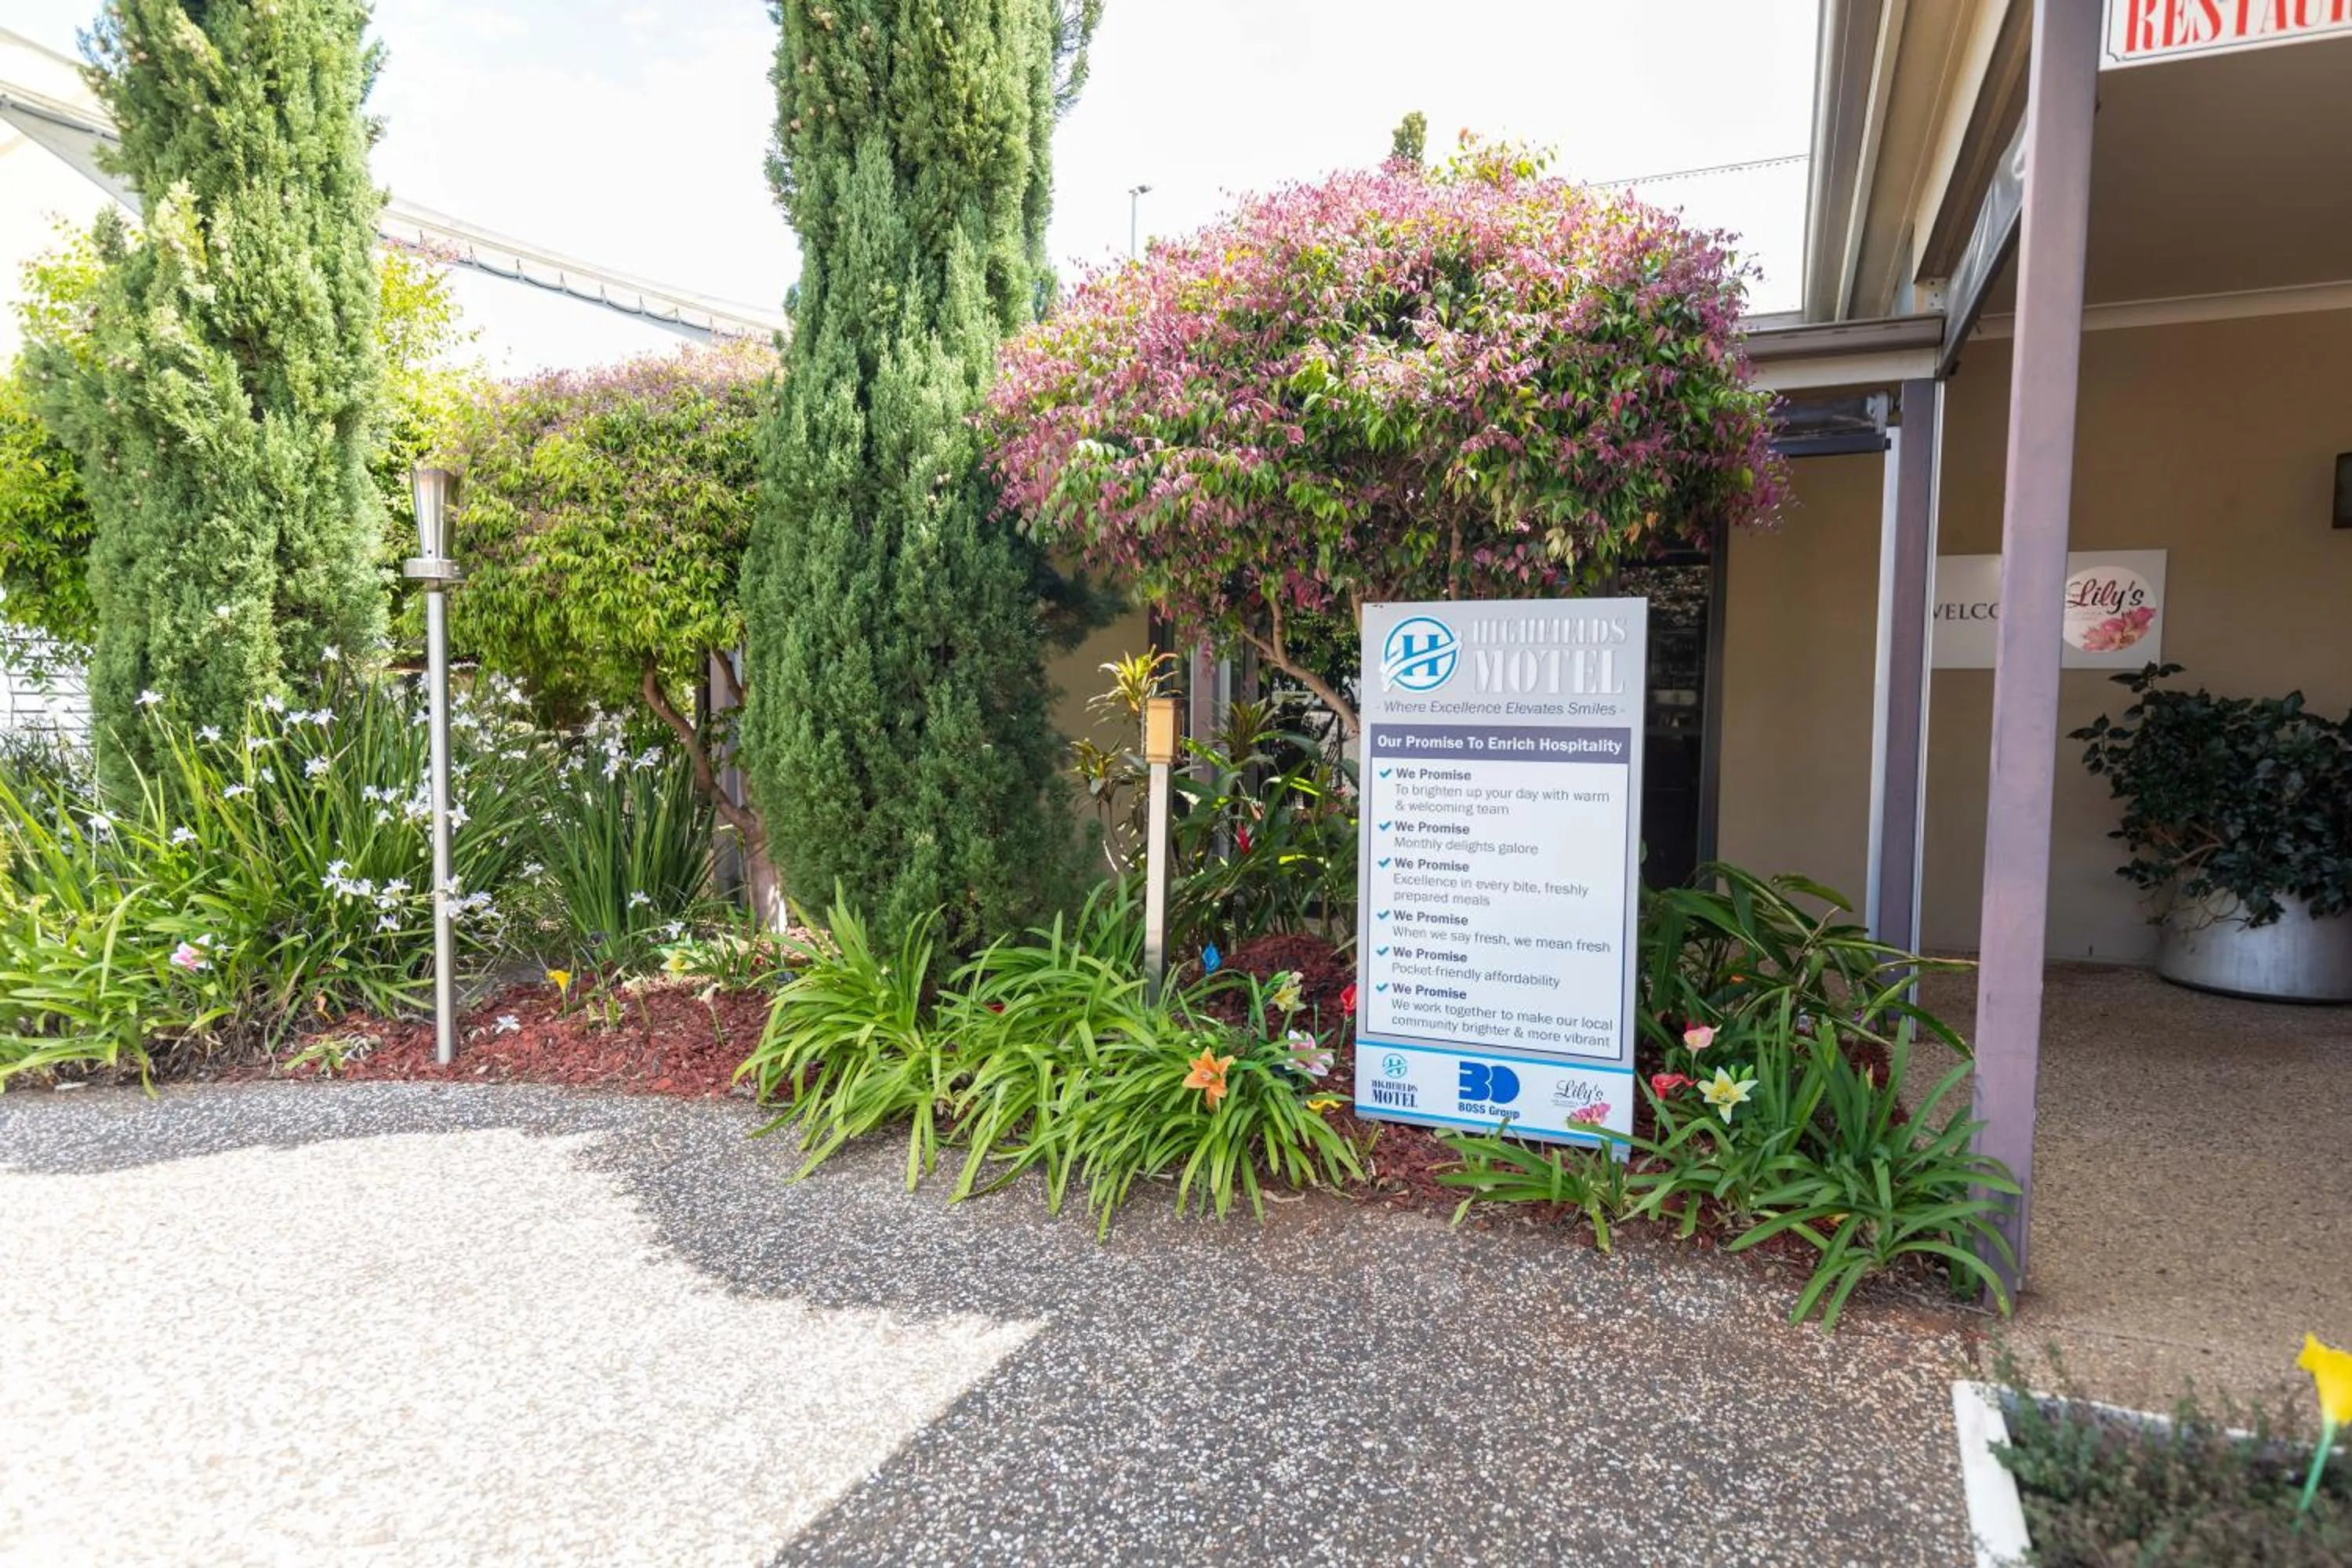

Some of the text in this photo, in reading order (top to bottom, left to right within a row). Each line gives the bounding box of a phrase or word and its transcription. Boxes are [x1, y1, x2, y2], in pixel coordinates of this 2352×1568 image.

[2067, 579, 2144, 615] Lily's
[1933, 602, 2000, 620] ELCO
[1473, 615, 1627, 644] HIGHFIELDS
[1471, 649, 1625, 694] MOTEL
[1385, 701, 1617, 716] Where Excellence Elevates Smiles
[1377, 735, 1622, 755] Our Promise To Enrich Hospitality
[1396, 768, 1472, 781] We Promise
[1396, 784, 1610, 802] To brighten up your day with warm
[1395, 800, 1509, 816] & welcoming team
[1395, 821, 1470, 835] We Promise
[1394, 837, 1539, 855] Monthly delights galore
[1395, 857, 1470, 873] We Promise
[1393, 873, 1588, 897] Excellence in every bite, freshly
[1393, 891, 1490, 906] prepared meals
[1393, 909, 1468, 925] We Promise
[1392, 926, 1611, 953] When we say fresh, we mean fresh
[1392, 946, 1468, 963] We Promise
[1392, 962, 1560, 989] Pocket-friendly affordability
[1392, 982, 1467, 1000] We Promise
[1392, 998, 1613, 1031] We work together to make our local
[1392, 1015, 1610, 1047] community brighter & more vibrant
[1372, 1089, 1418, 1108] MOTEL
[1554, 1079, 1603, 1106] Lily's
[1458, 1102, 1520, 1120] BOSS Group
